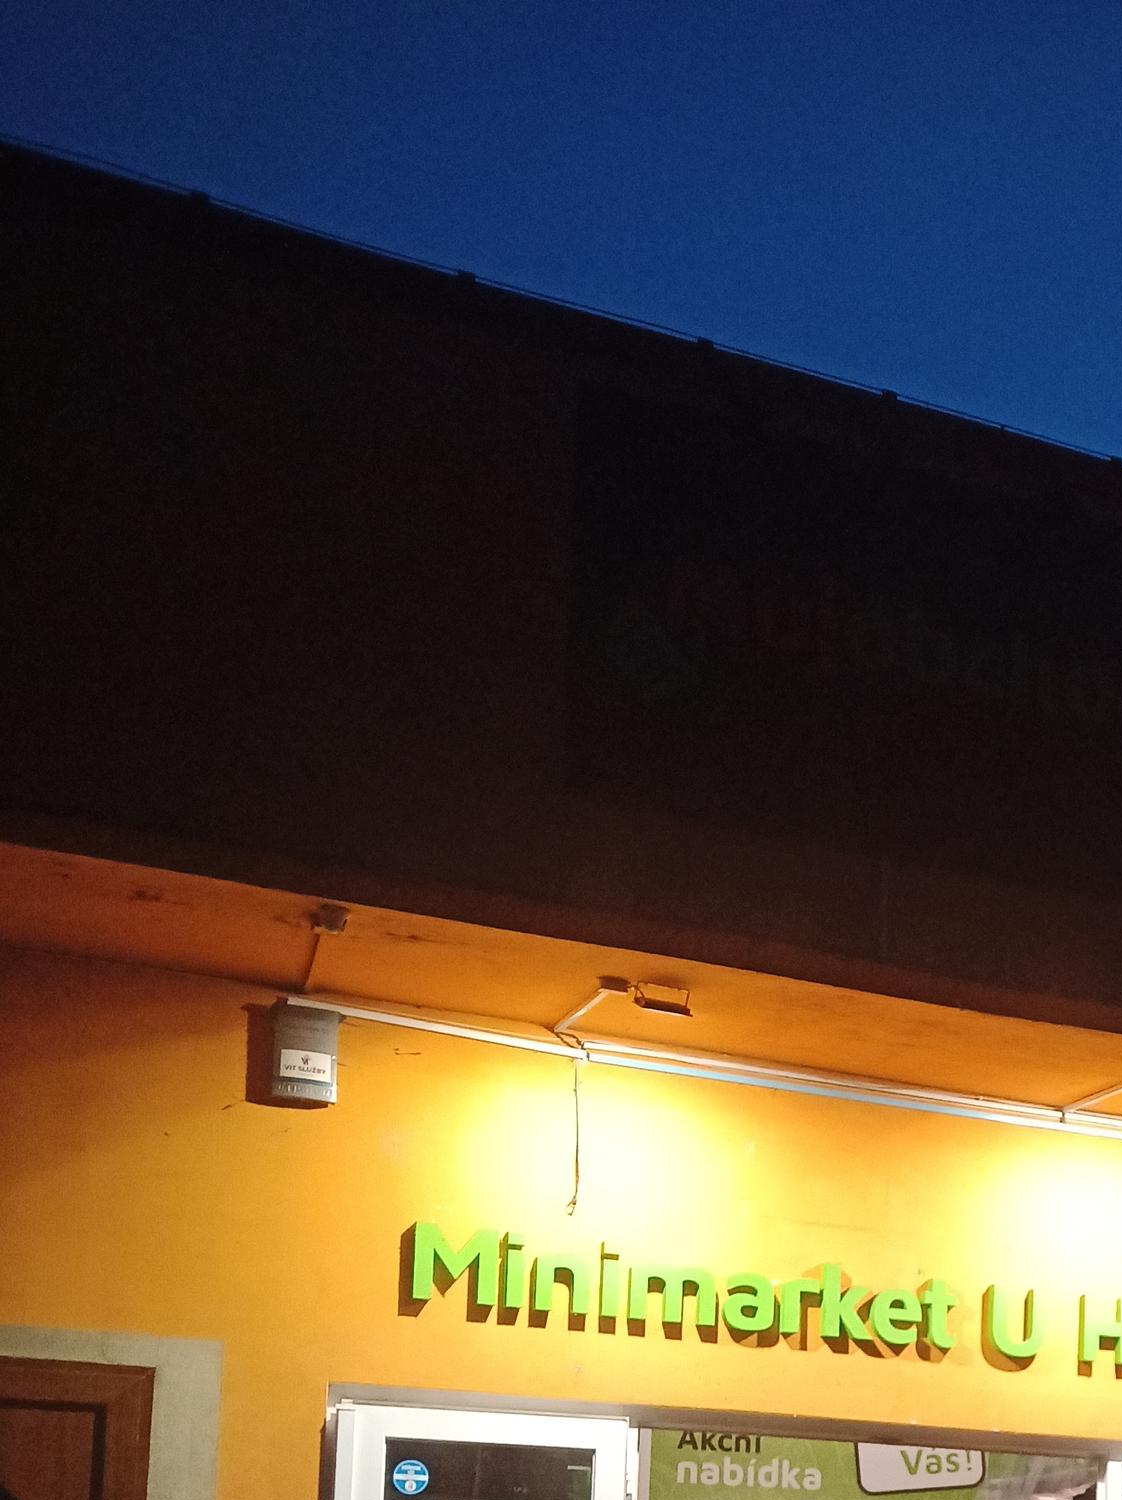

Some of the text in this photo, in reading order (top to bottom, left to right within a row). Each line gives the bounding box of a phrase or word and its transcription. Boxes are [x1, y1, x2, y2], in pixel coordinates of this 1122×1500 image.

[404, 1221, 958, 1353] Minimarket
[984, 1283, 1038, 1364] U
[676, 1456, 822, 1491] nabídka
